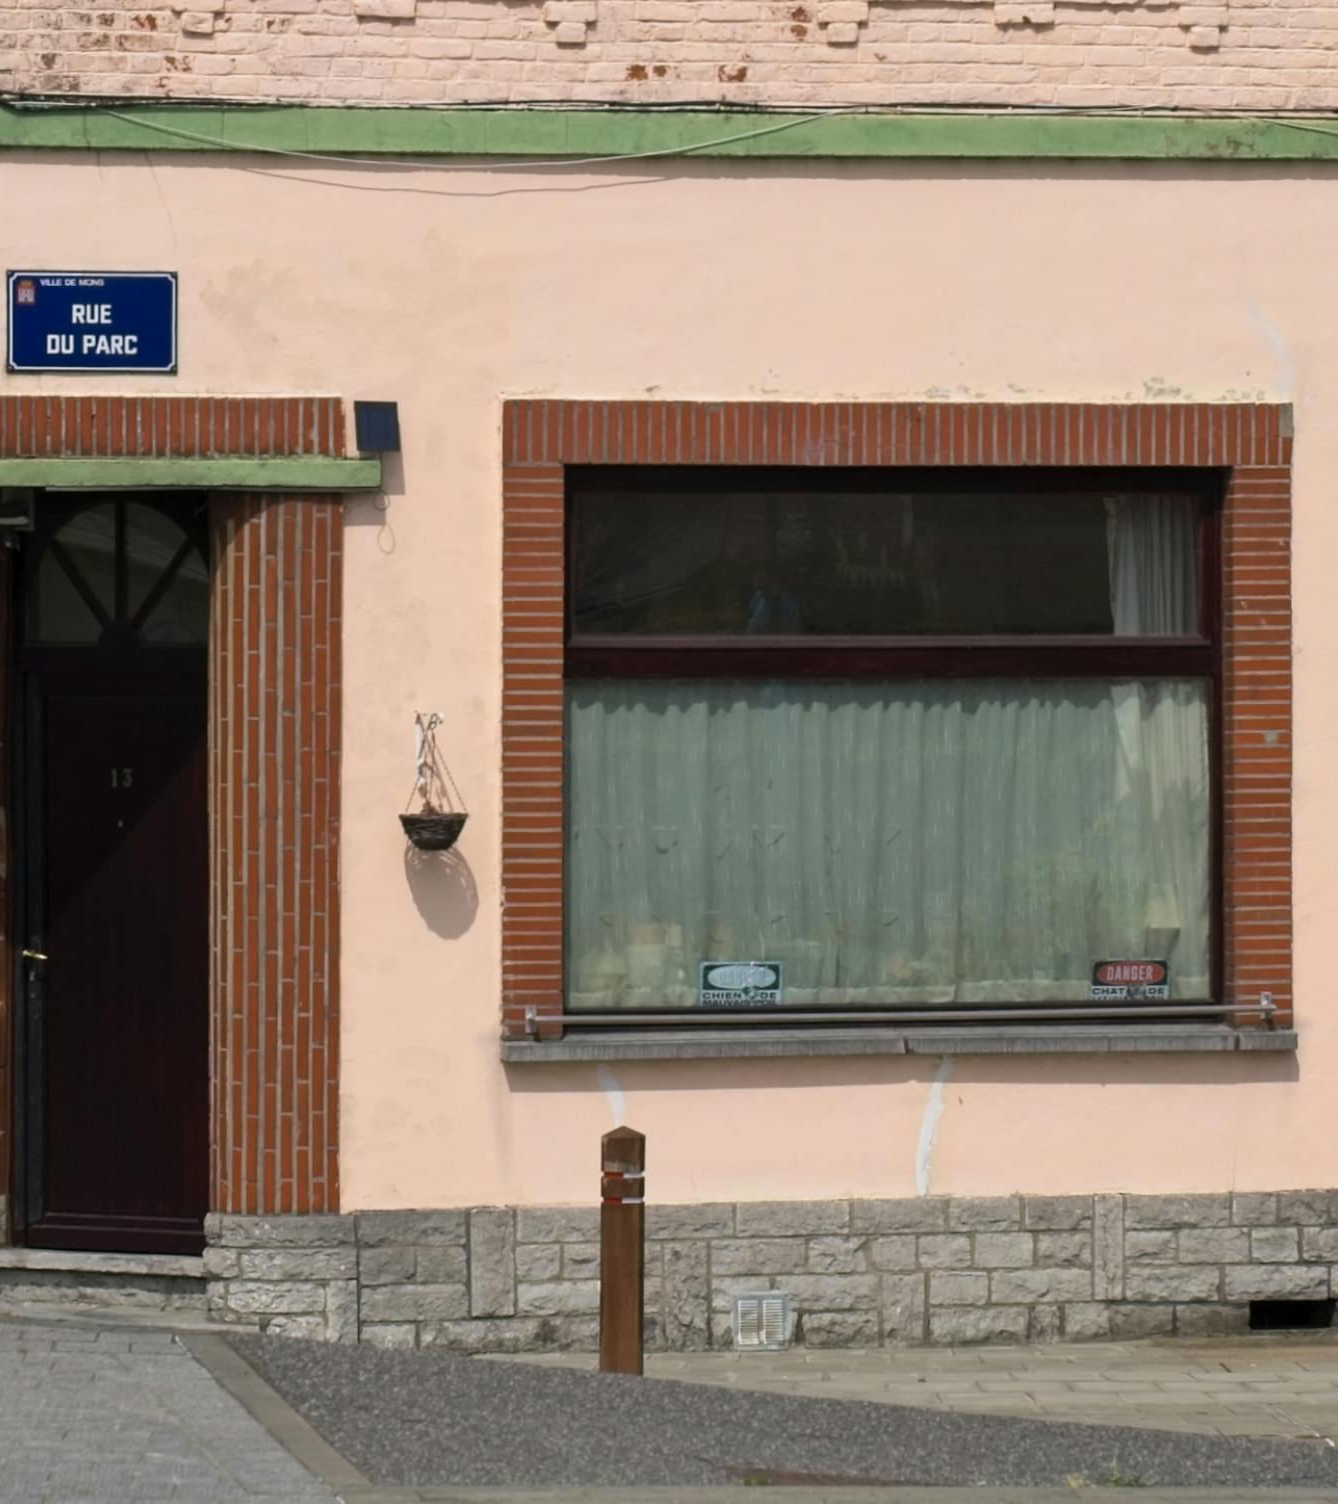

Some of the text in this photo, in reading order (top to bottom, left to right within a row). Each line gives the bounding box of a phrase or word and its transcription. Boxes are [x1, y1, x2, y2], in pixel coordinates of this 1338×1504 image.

[40, 278, 105, 287] VILLE DE MONS
[71, 304, 112, 324] RUE
[46, 334, 138, 355] DU PARC
[110, 768, 132, 788] 13
[1106, 965, 1154, 981] DANGER
[1092, 987, 1165, 995] CHAT DE
